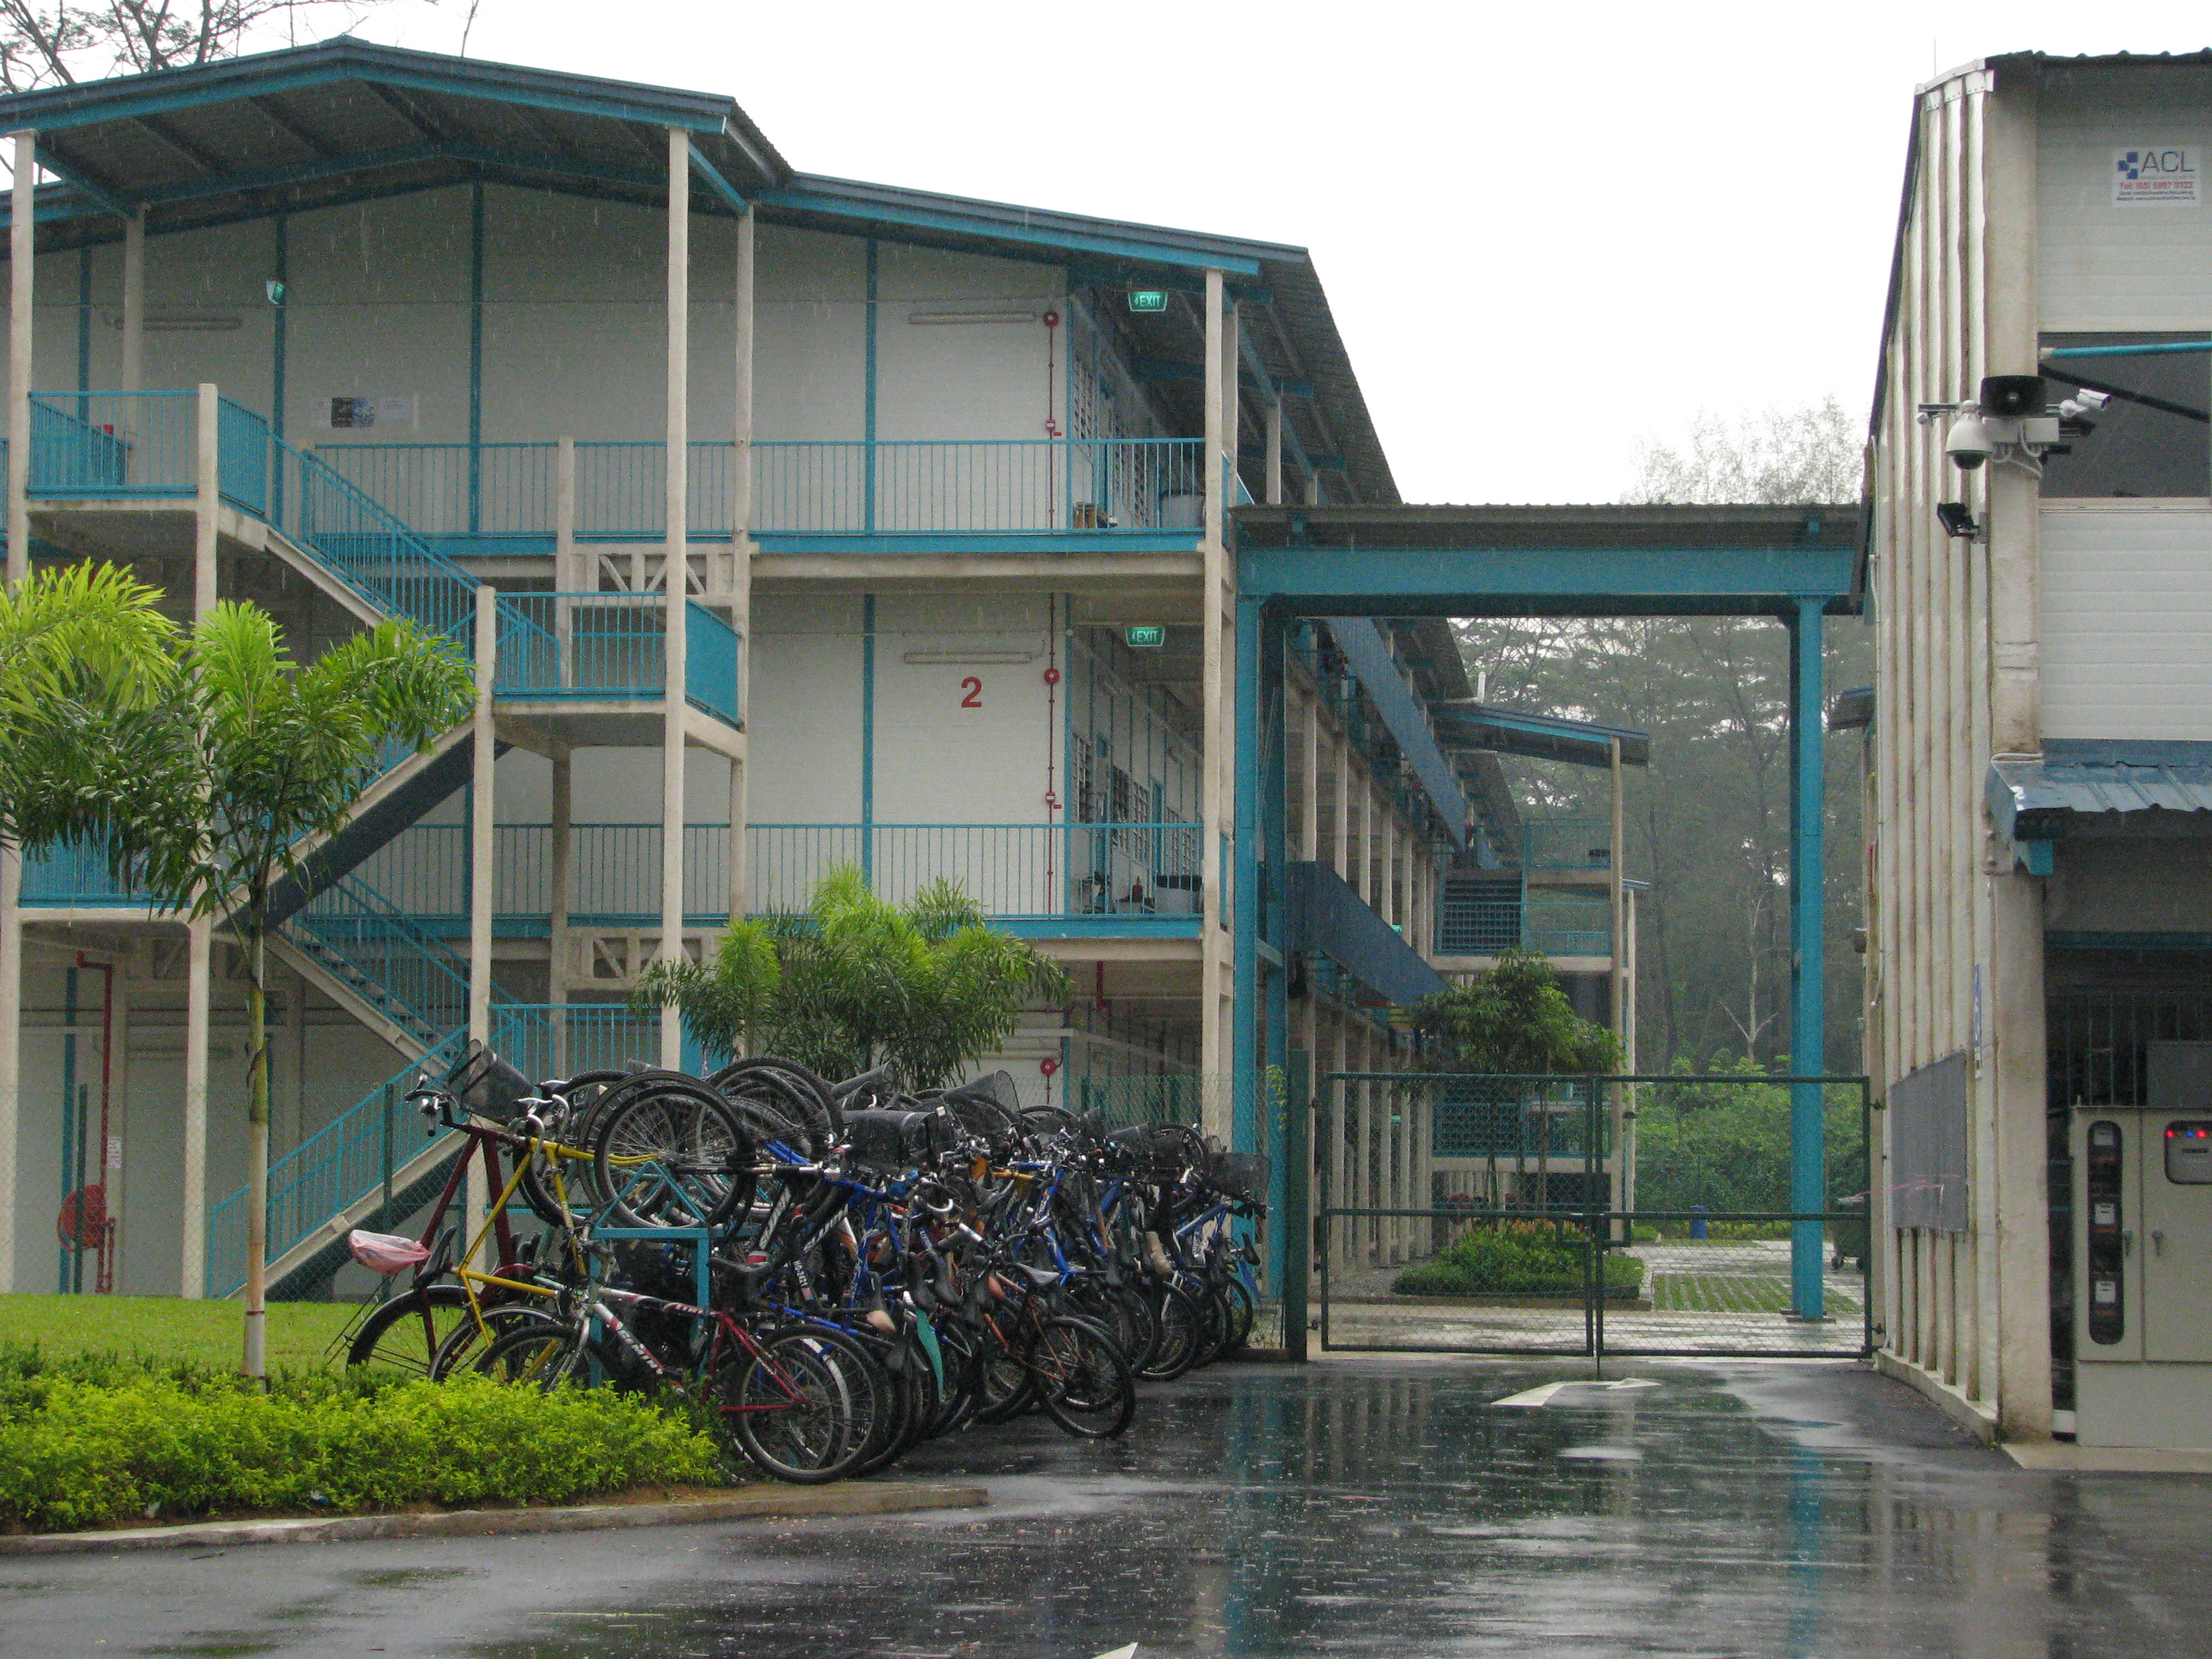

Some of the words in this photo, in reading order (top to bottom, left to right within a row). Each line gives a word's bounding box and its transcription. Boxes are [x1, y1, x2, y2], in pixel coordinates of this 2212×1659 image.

[2142, 151, 2195, 173] ACL
[1139, 295, 1161, 307] EXIT
[1136, 630, 1158, 642] EXIT
[961, 676, 982, 708] 2
